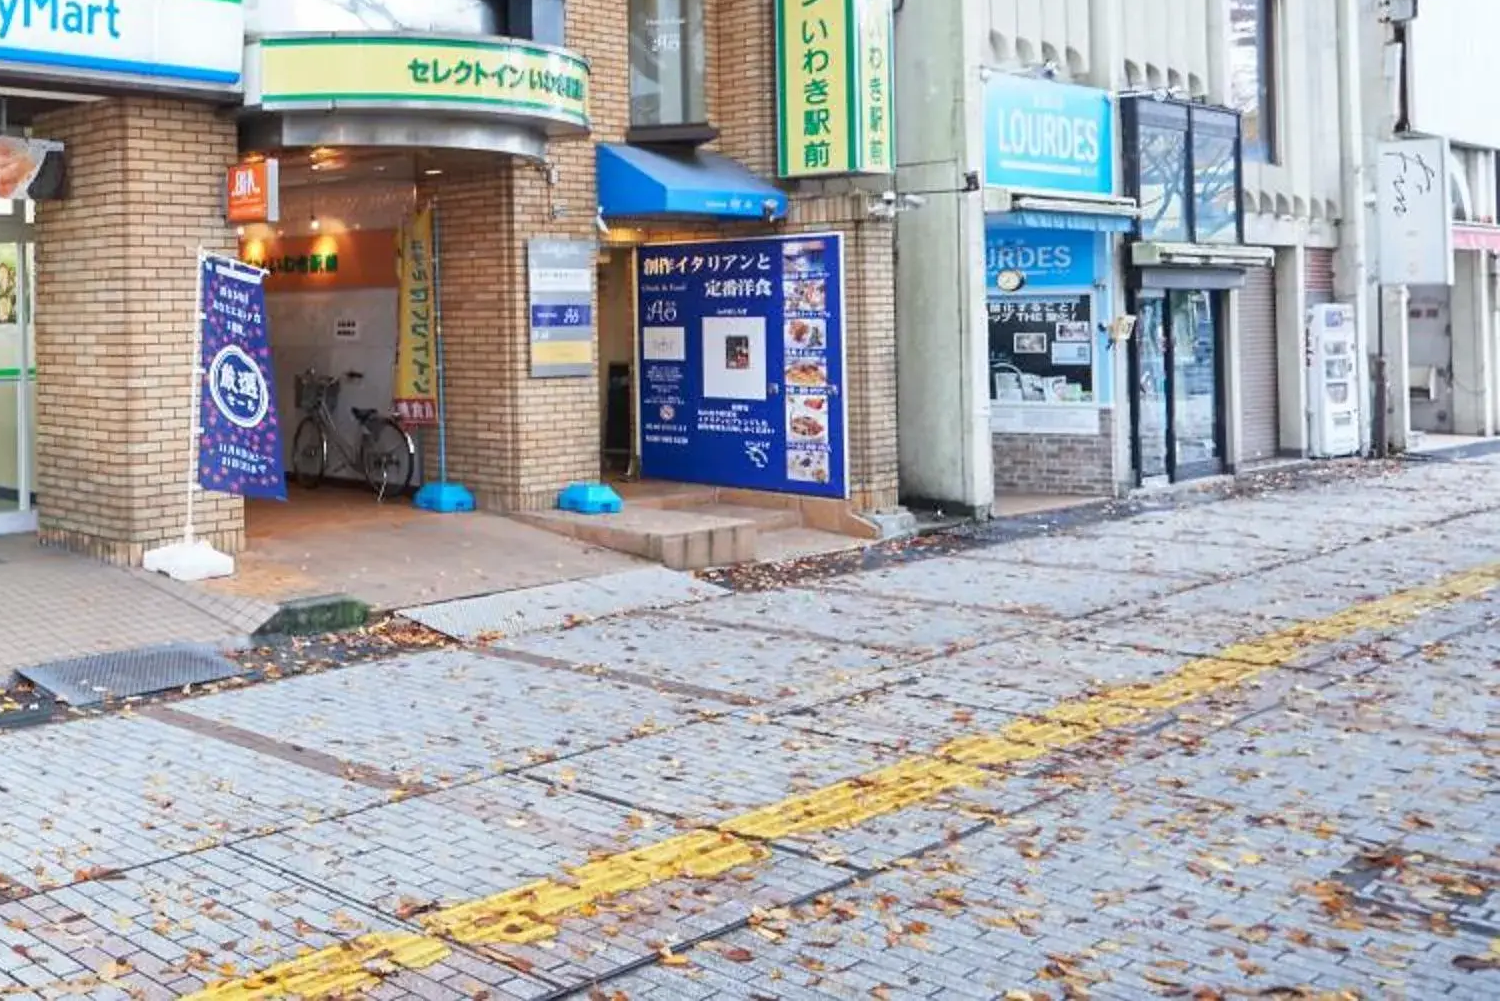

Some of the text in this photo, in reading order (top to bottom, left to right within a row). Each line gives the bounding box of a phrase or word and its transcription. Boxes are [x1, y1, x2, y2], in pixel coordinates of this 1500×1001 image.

[408, 58, 525, 89] セレクトイン
[801, 19, 831, 168] いわき駅前
[998, 107, 1099, 164] LOURDES
[642, 252, 772, 277] 創作イタリアンと
[987, 245, 1071, 270] URDES
[705, 278, 773, 299] 定番洋食
